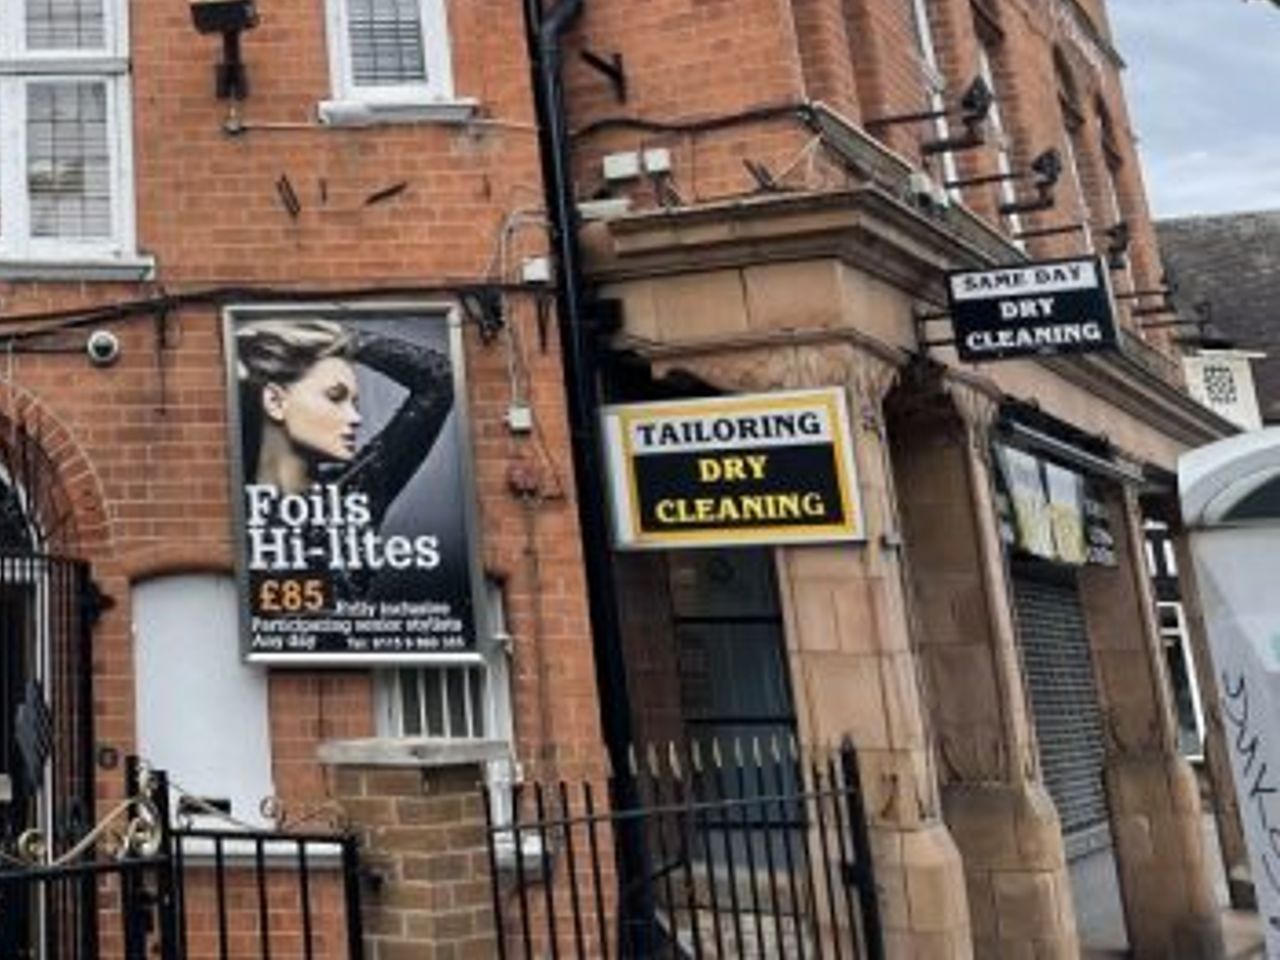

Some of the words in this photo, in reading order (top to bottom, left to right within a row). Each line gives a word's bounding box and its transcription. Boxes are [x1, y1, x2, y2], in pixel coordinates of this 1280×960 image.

[963, 269, 1025, 291] SAME
[1034, 264, 1082, 285] DAY
[998, 296, 1055, 321] DRY
[966, 320, 1102, 351] CLEANING
[636, 411, 822, 447] TAILORING
[698, 454, 769, 482] DRY
[245, 484, 371, 527] Foils
[655, 491, 826, 524] CLEANING
[248, 526, 441, 571] Hi-lites
[259, 579, 324, 612] £85
